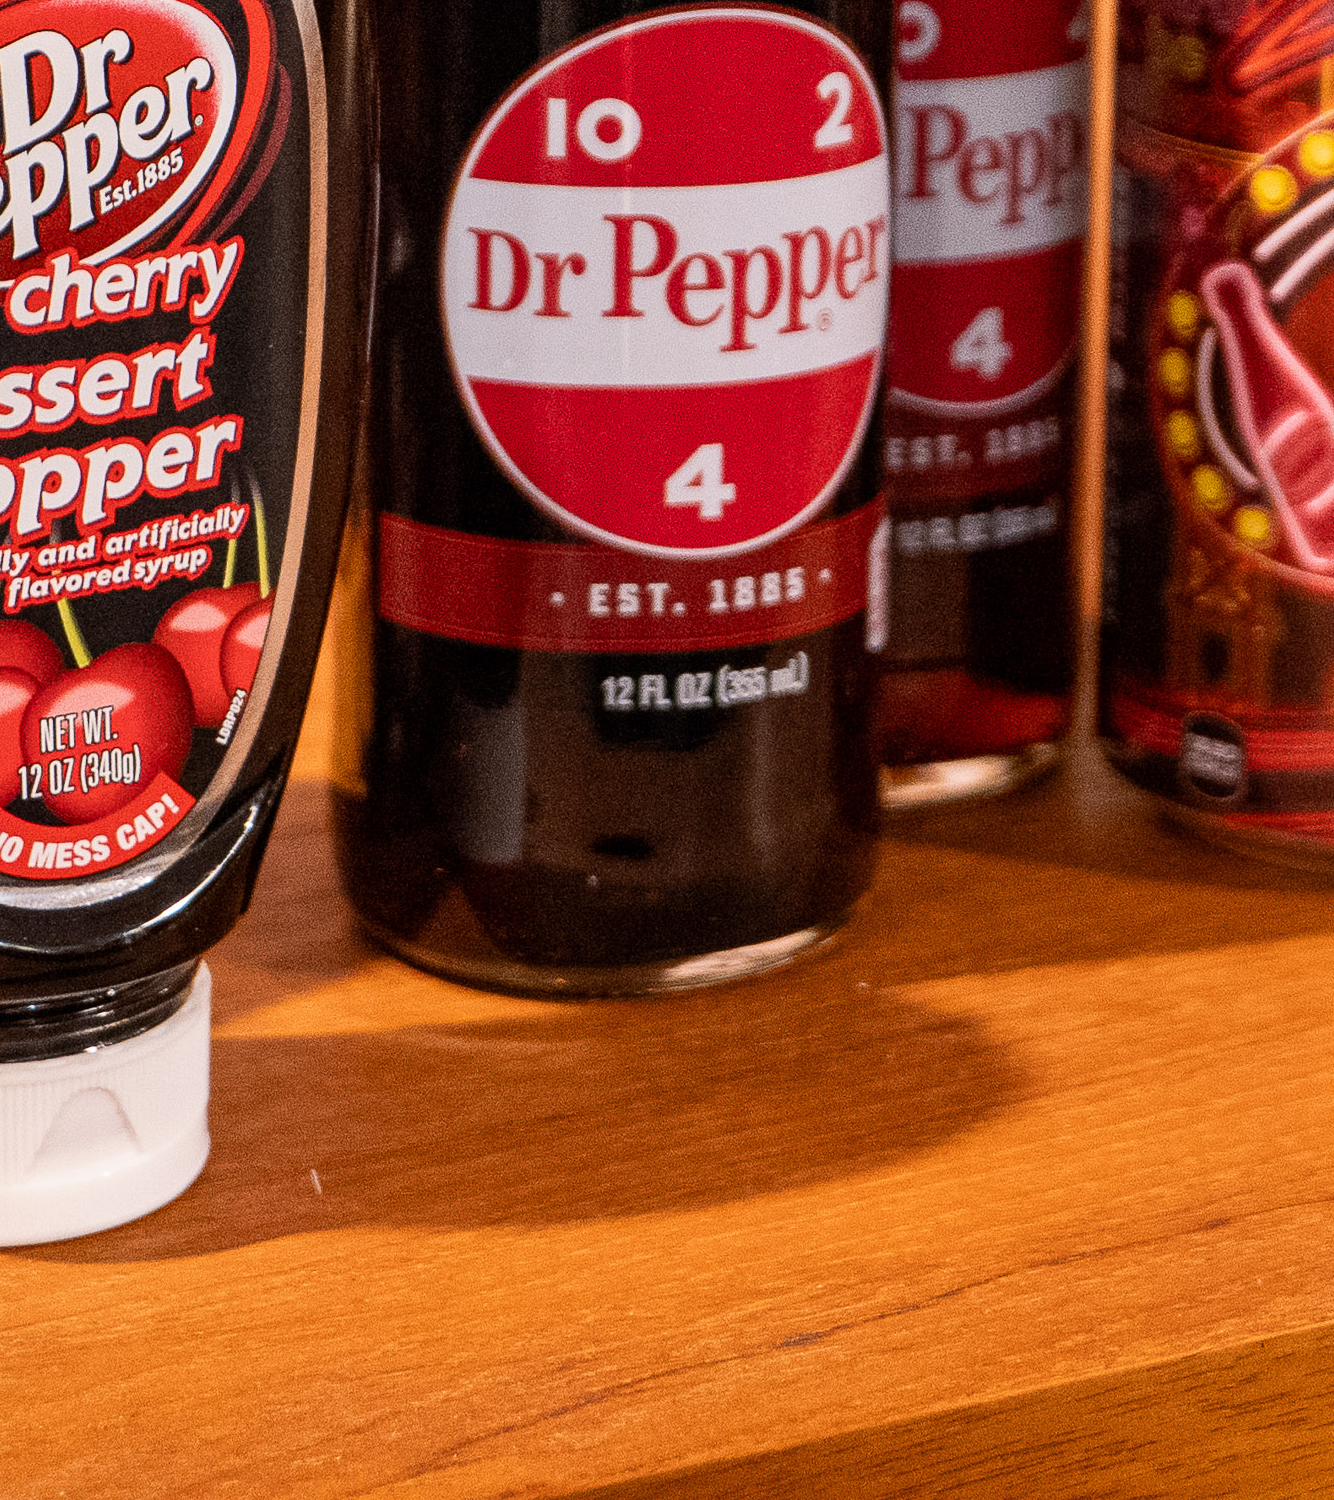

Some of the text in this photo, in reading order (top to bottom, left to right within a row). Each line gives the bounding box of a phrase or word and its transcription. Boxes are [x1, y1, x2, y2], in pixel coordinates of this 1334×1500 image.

[544, 71, 855, 162] 10 2
[98, 149, 185, 215] Est.1885
[907, 102, 1085, 228] Pepp
[8, 242, 239, 331] cherry
[467, 213, 887, 354] Dr Pepper
[948, 305, 1015, 384] 4
[663, 443, 737, 521] 4
[37, 536, 97, 567] and
[105, 505, 247, 556] artificially
[7, 545, 208, 609] flavored syrup
[588, 565, 806, 618] EST. 1885
[600, 675, 635, 711] 12
[675, 671, 714, 710] OZ
[39, 704, 119, 754] NET WT.
[17, 743, 142, 800] 12 OZ (340g)
[27, 834, 111, 870] MESS
[115, 792, 181, 851] CAP!
